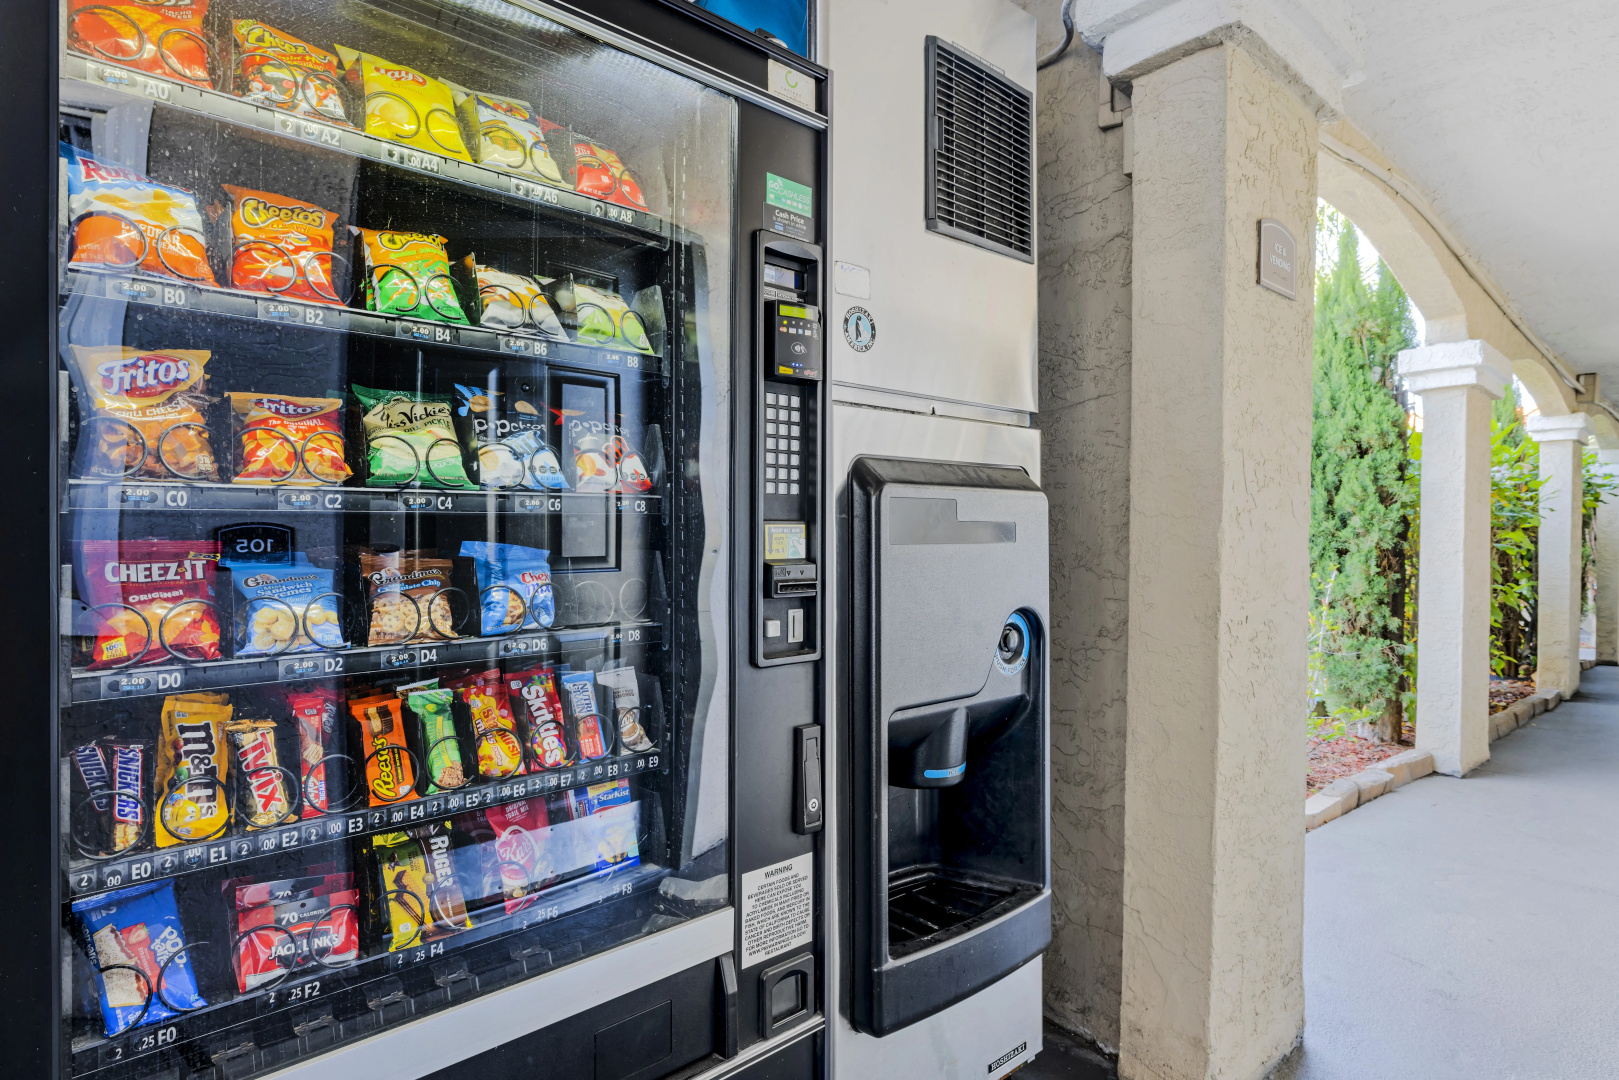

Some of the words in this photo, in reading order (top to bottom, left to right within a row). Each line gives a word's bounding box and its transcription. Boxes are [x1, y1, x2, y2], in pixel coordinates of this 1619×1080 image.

[145, 84, 170, 100] A0
[320, 130, 340, 146] A2
[422, 157, 438, 171] A4
[544, 190, 558, 204] A6
[778, 188, 810, 205] CASHLESS
[241, 198, 326, 228] Cheetos
[620, 210, 632, 223] A8
[775, 209, 790, 220] Cash
[790, 214, 804, 224] Price
[122, 282, 148, 292] 2.00
[164, 288, 186, 304] B0
[269, 304, 290, 312] 2.00
[306, 310, 324, 324] B2
[412, 326, 430, 335] 2.00
[436, 328, 450, 342] B4
[534, 342, 547, 356] B6
[627, 356, 638, 368] B8
[97, 356, 190, 396] Fritos
[126, 488, 150, 496] 2.00
[166, 490, 188, 506] C0
[291, 494, 312, 502] 2.00
[324, 494, 342, 508] C2
[438, 496, 453, 510] C4
[548, 498, 561, 511] C6
[634, 500, 646, 512] C8
[521, 572, 550, 584] Chex
[256, 582, 314, 596] Sandwich
[628, 630, 640, 642] D8
[532, 638, 546, 651] D6
[391, 654, 409, 662] 2.00
[420, 648, 438, 662] D4
[294, 661, 314, 669] 2.00
[324, 658, 343, 672] D2
[120, 677, 146, 686] 2.00
[158, 672, 181, 690] D0
[373, 736, 397, 797] Reese's
[648, 756, 659, 768] E9
[608, 764, 618, 776] E8
[560, 774, 572, 788] E7
[513, 783, 526, 797] E6
[598, 788, 630, 802] StarKist
[466, 794, 478, 808] E5
[390, 812, 403, 823] .00
[410, 805, 424, 820] E4
[328, 822, 342, 834] .00
[348, 818, 364, 833] E3
[260, 838, 276, 850] .00
[282, 832, 298, 848] E2
[210, 846, 228, 863] E1
[429, 836, 454, 888] RUGER
[132, 862, 151, 880] E0
[764, 863, 792, 878] WARNING
[104, 876, 122, 888] .00
[622, 883, 632, 896] F8
[280, 912, 298, 925] 70
[536, 908, 546, 920] .25
[547, 906, 558, 919] F6
[414, 951, 426, 963] .25
[430, 942, 444, 958] F4
[288, 988, 302, 1001] .25
[304, 982, 320, 998] F2
[138, 1035, 154, 1050] .25
[158, 1027, 176, 1046] F0
